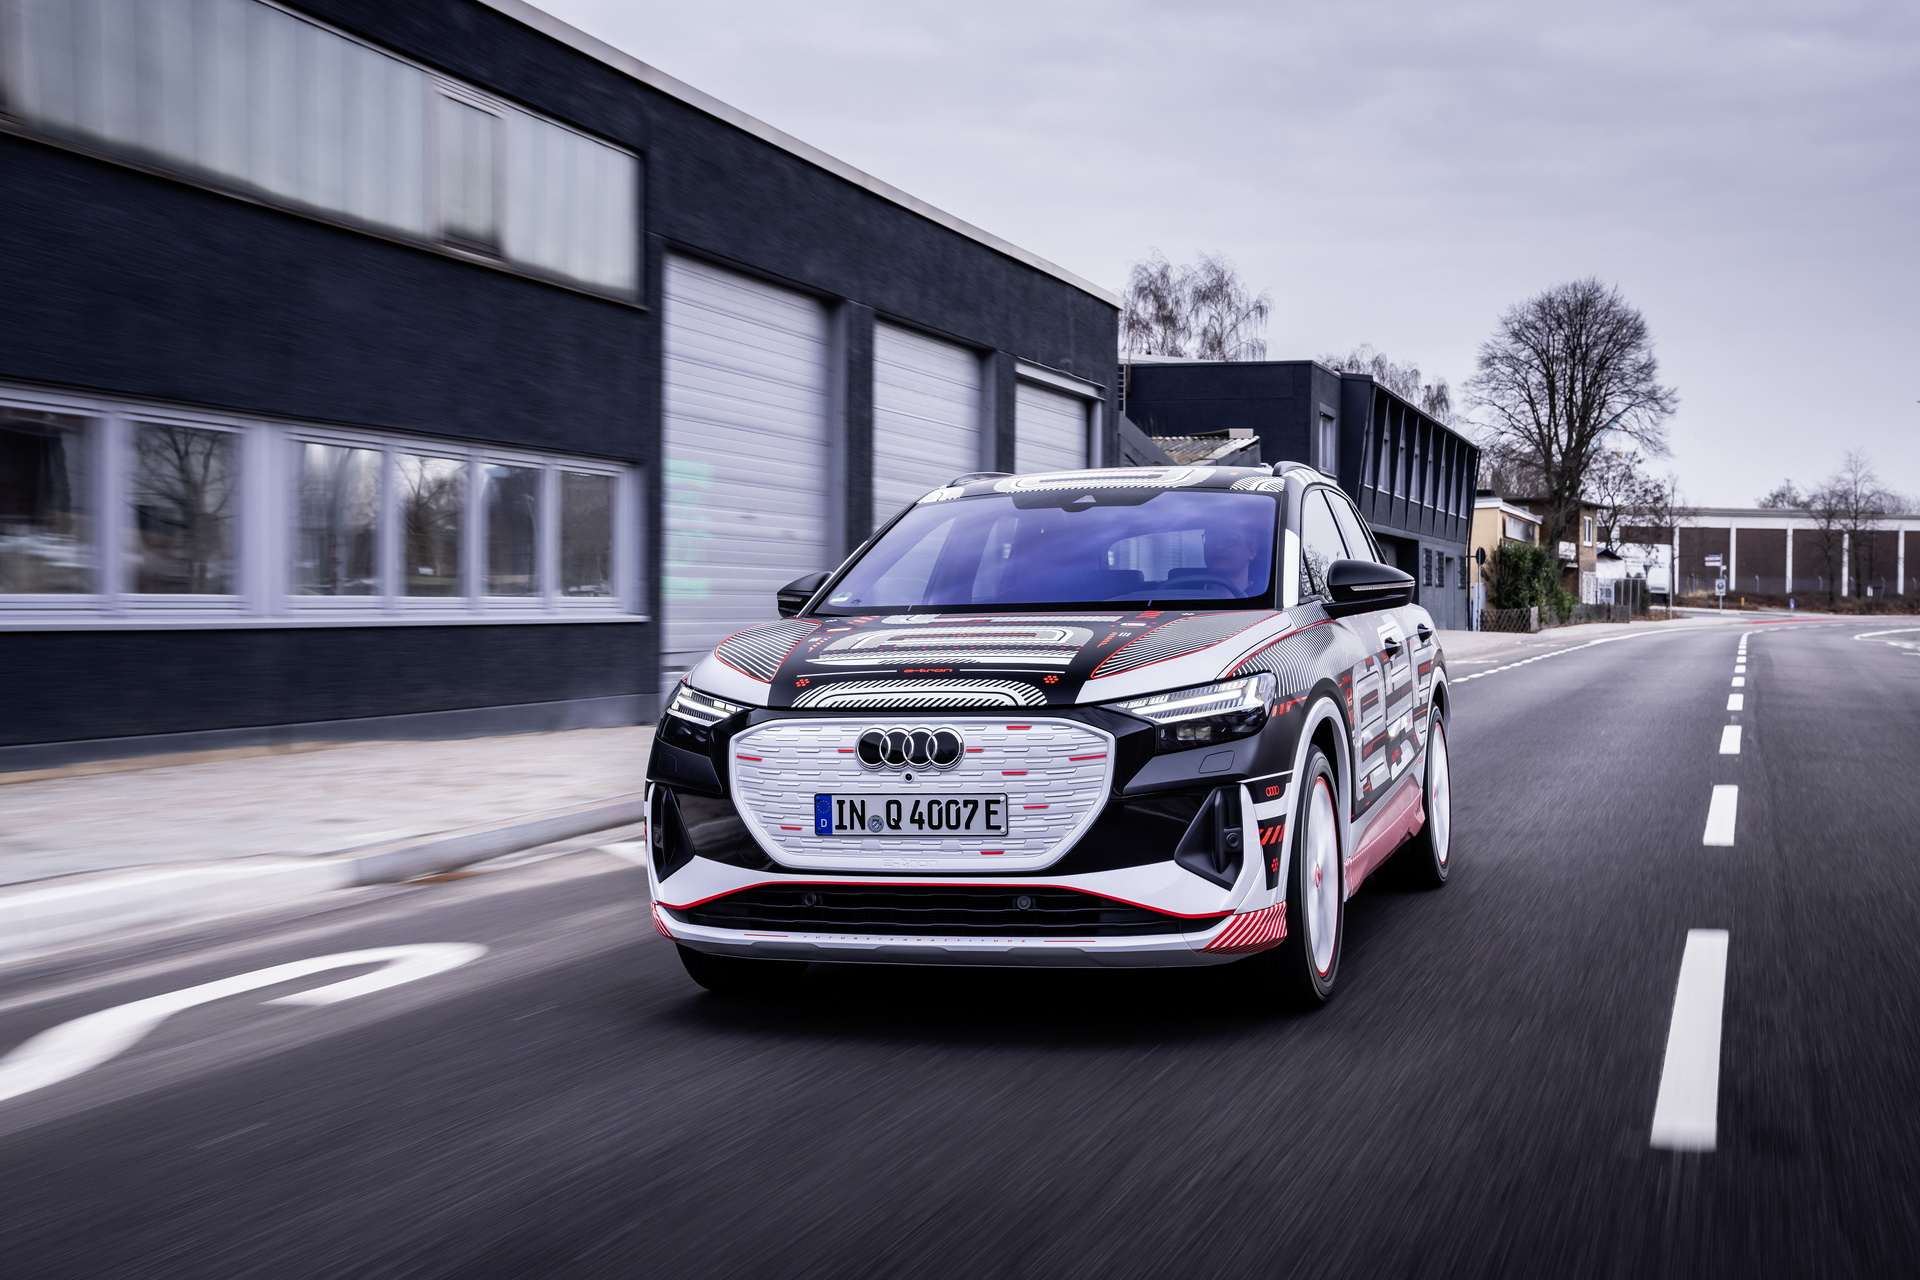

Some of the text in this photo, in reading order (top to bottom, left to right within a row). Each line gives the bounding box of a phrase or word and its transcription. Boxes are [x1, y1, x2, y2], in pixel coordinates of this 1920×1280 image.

[820, 818, 827, 827] D
[835, 799, 866, 830] IN
[885, 799, 902, 830] Q
